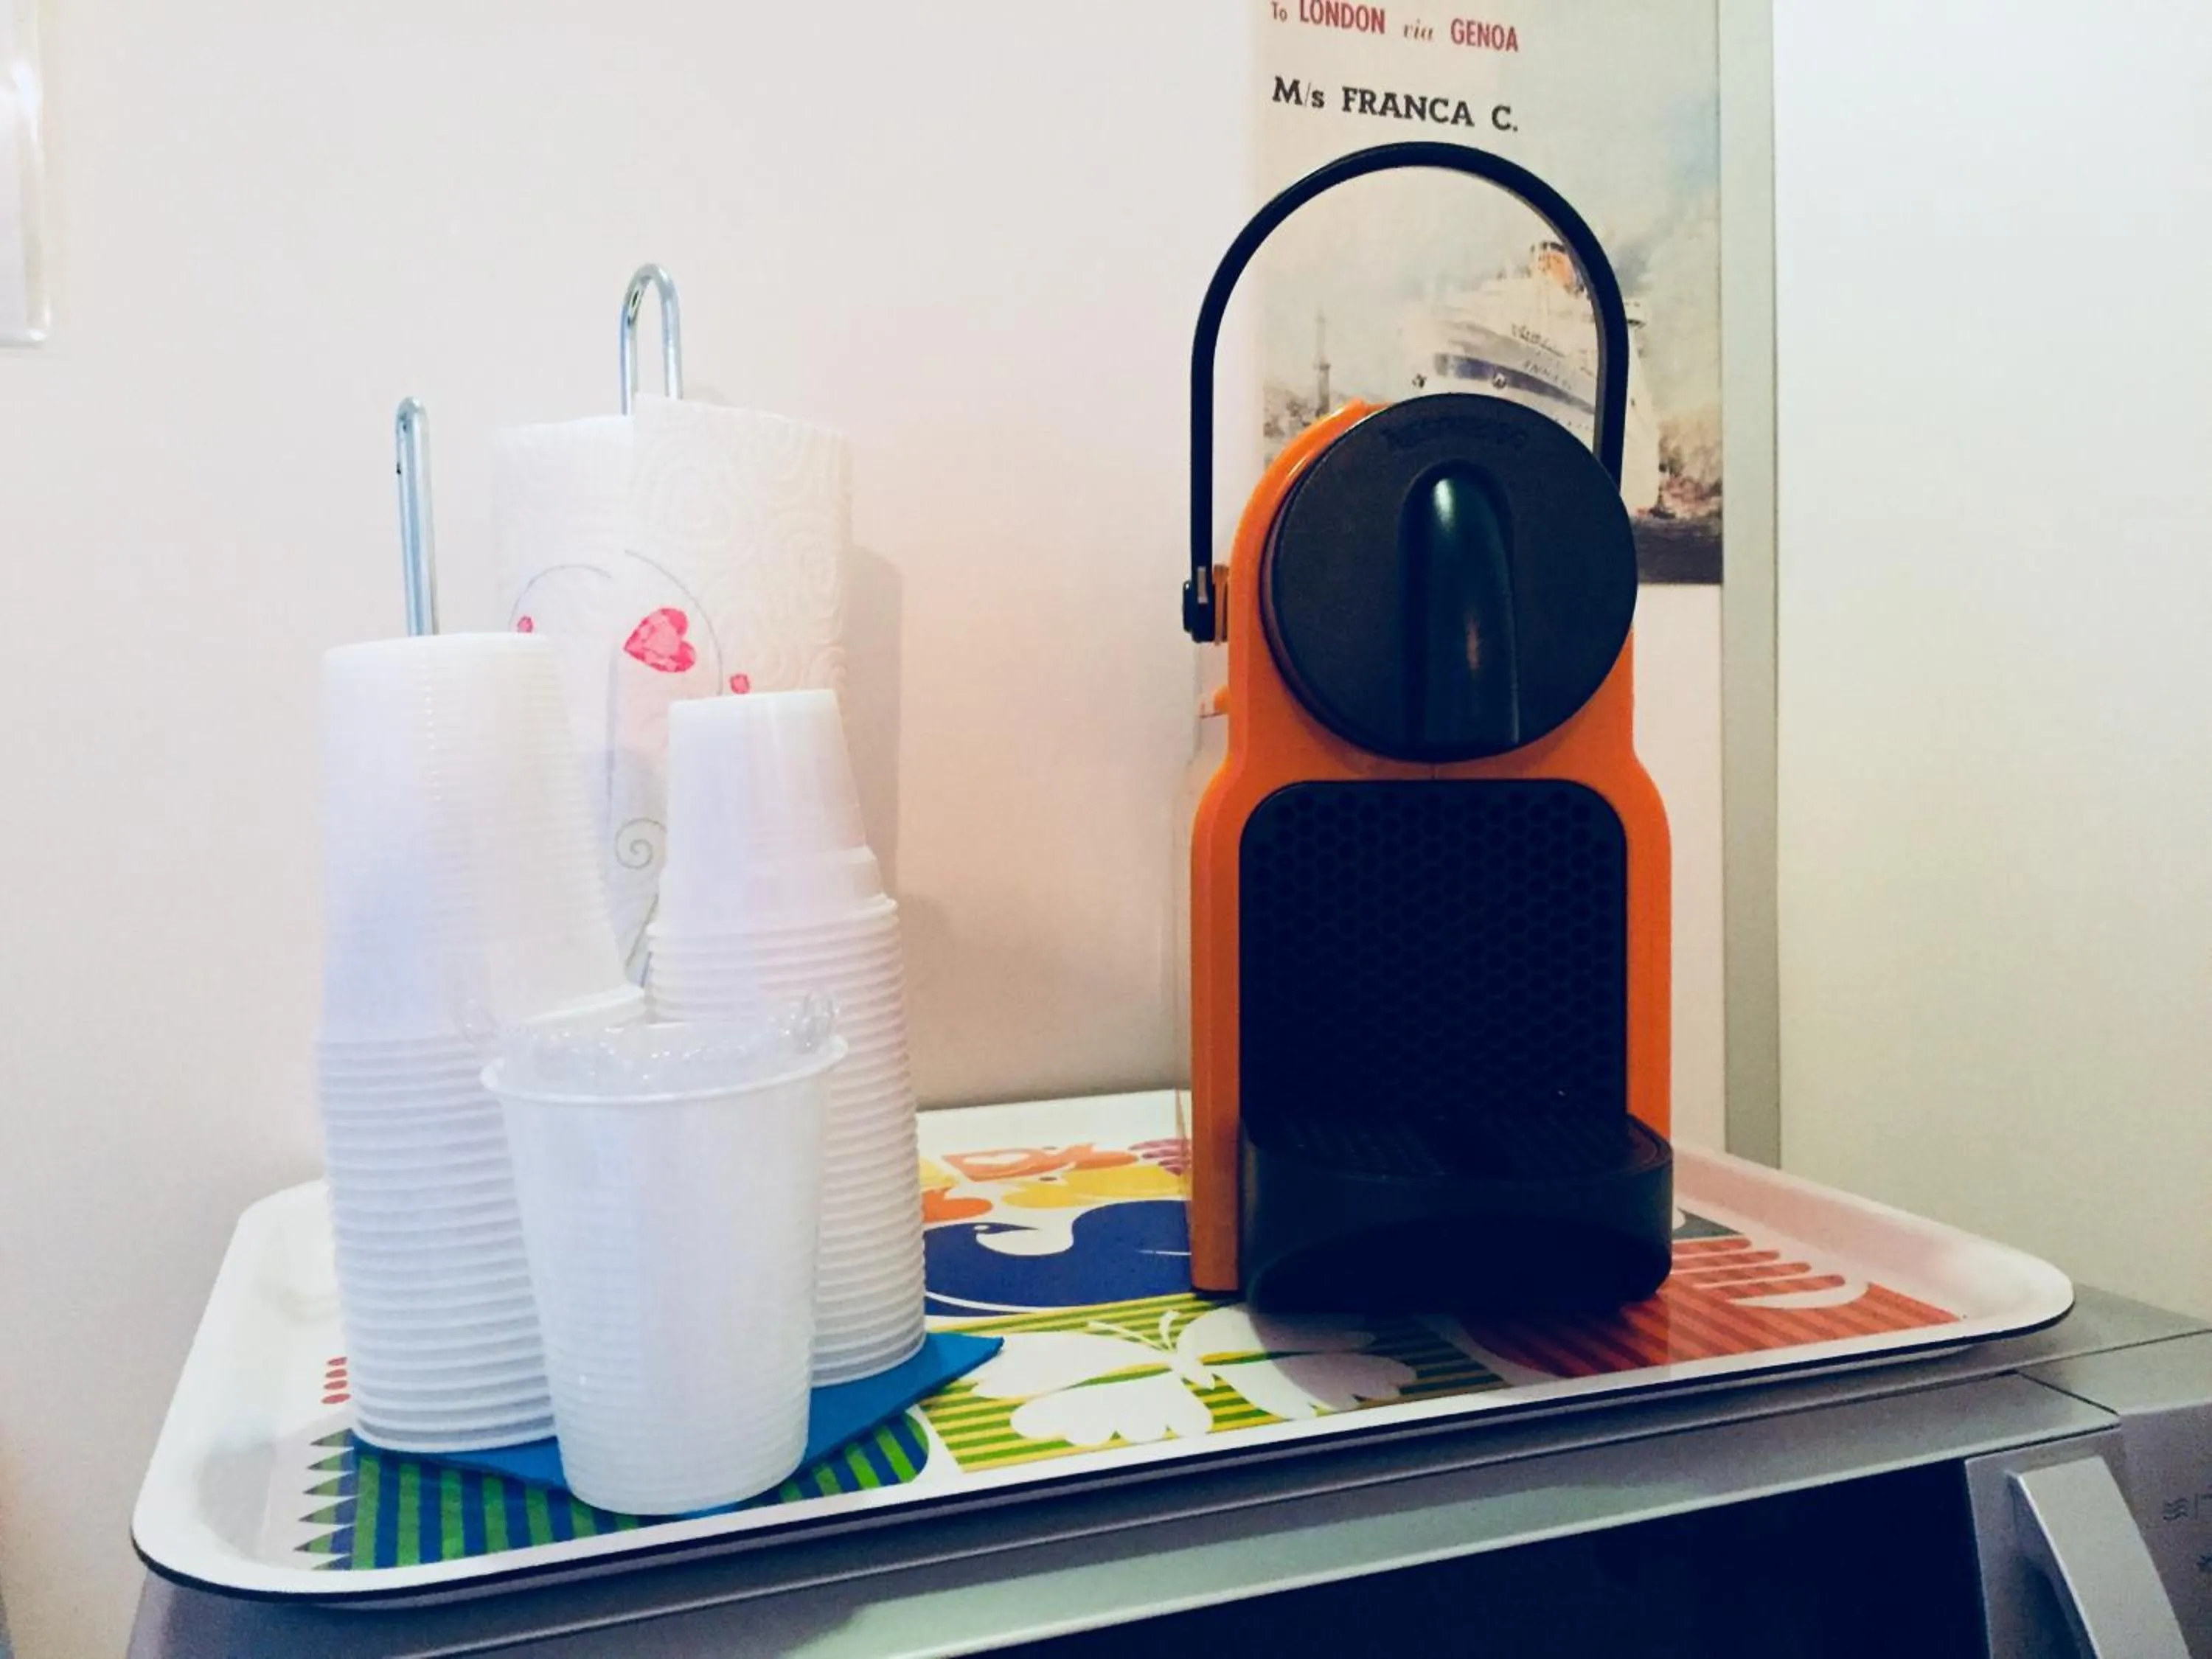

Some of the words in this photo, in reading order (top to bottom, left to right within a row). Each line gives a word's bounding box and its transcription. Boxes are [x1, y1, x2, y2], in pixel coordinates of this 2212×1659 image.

[1272, 1, 1288, 22] To
[1299, 0, 1385, 35] LONDON
[1403, 18, 1433, 41] via
[1450, 18, 1519, 52] GENOA
[1272, 75, 1325, 108] M/s
[1342, 86, 1475, 127] FRANCA
[1492, 105, 1518, 132] C.
